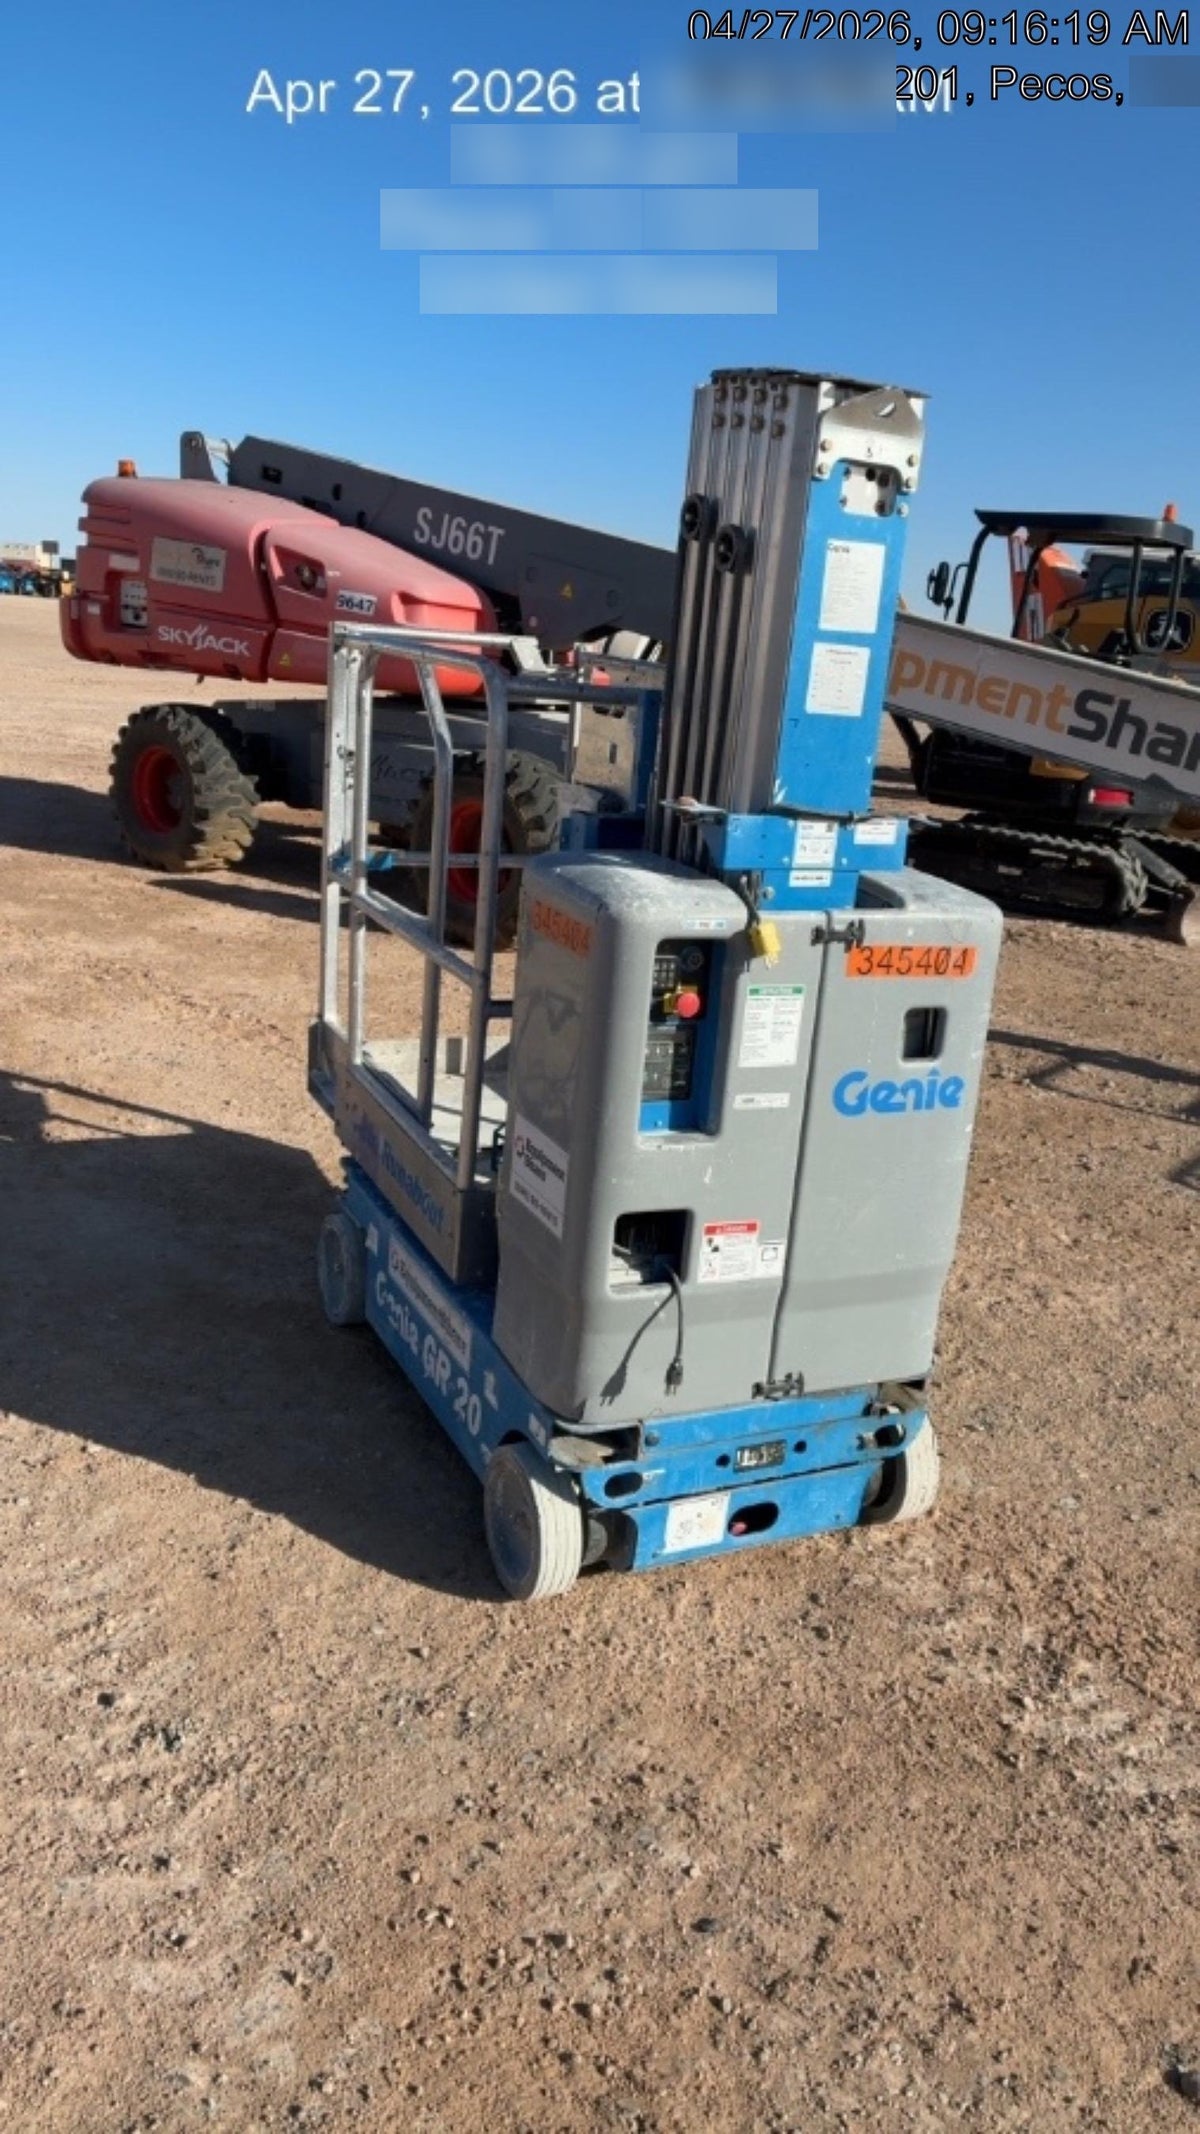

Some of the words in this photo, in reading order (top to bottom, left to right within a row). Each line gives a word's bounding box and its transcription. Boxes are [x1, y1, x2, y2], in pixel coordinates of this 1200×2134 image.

[413, 506, 505, 566] SJ66T
[157, 624, 250, 656] SKYJACK
[857, 945, 969, 976] 345404
[832, 1066, 965, 1118] Genie
[422, 1334, 451, 1396] GR
[453, 1376, 483, 1436] 20
